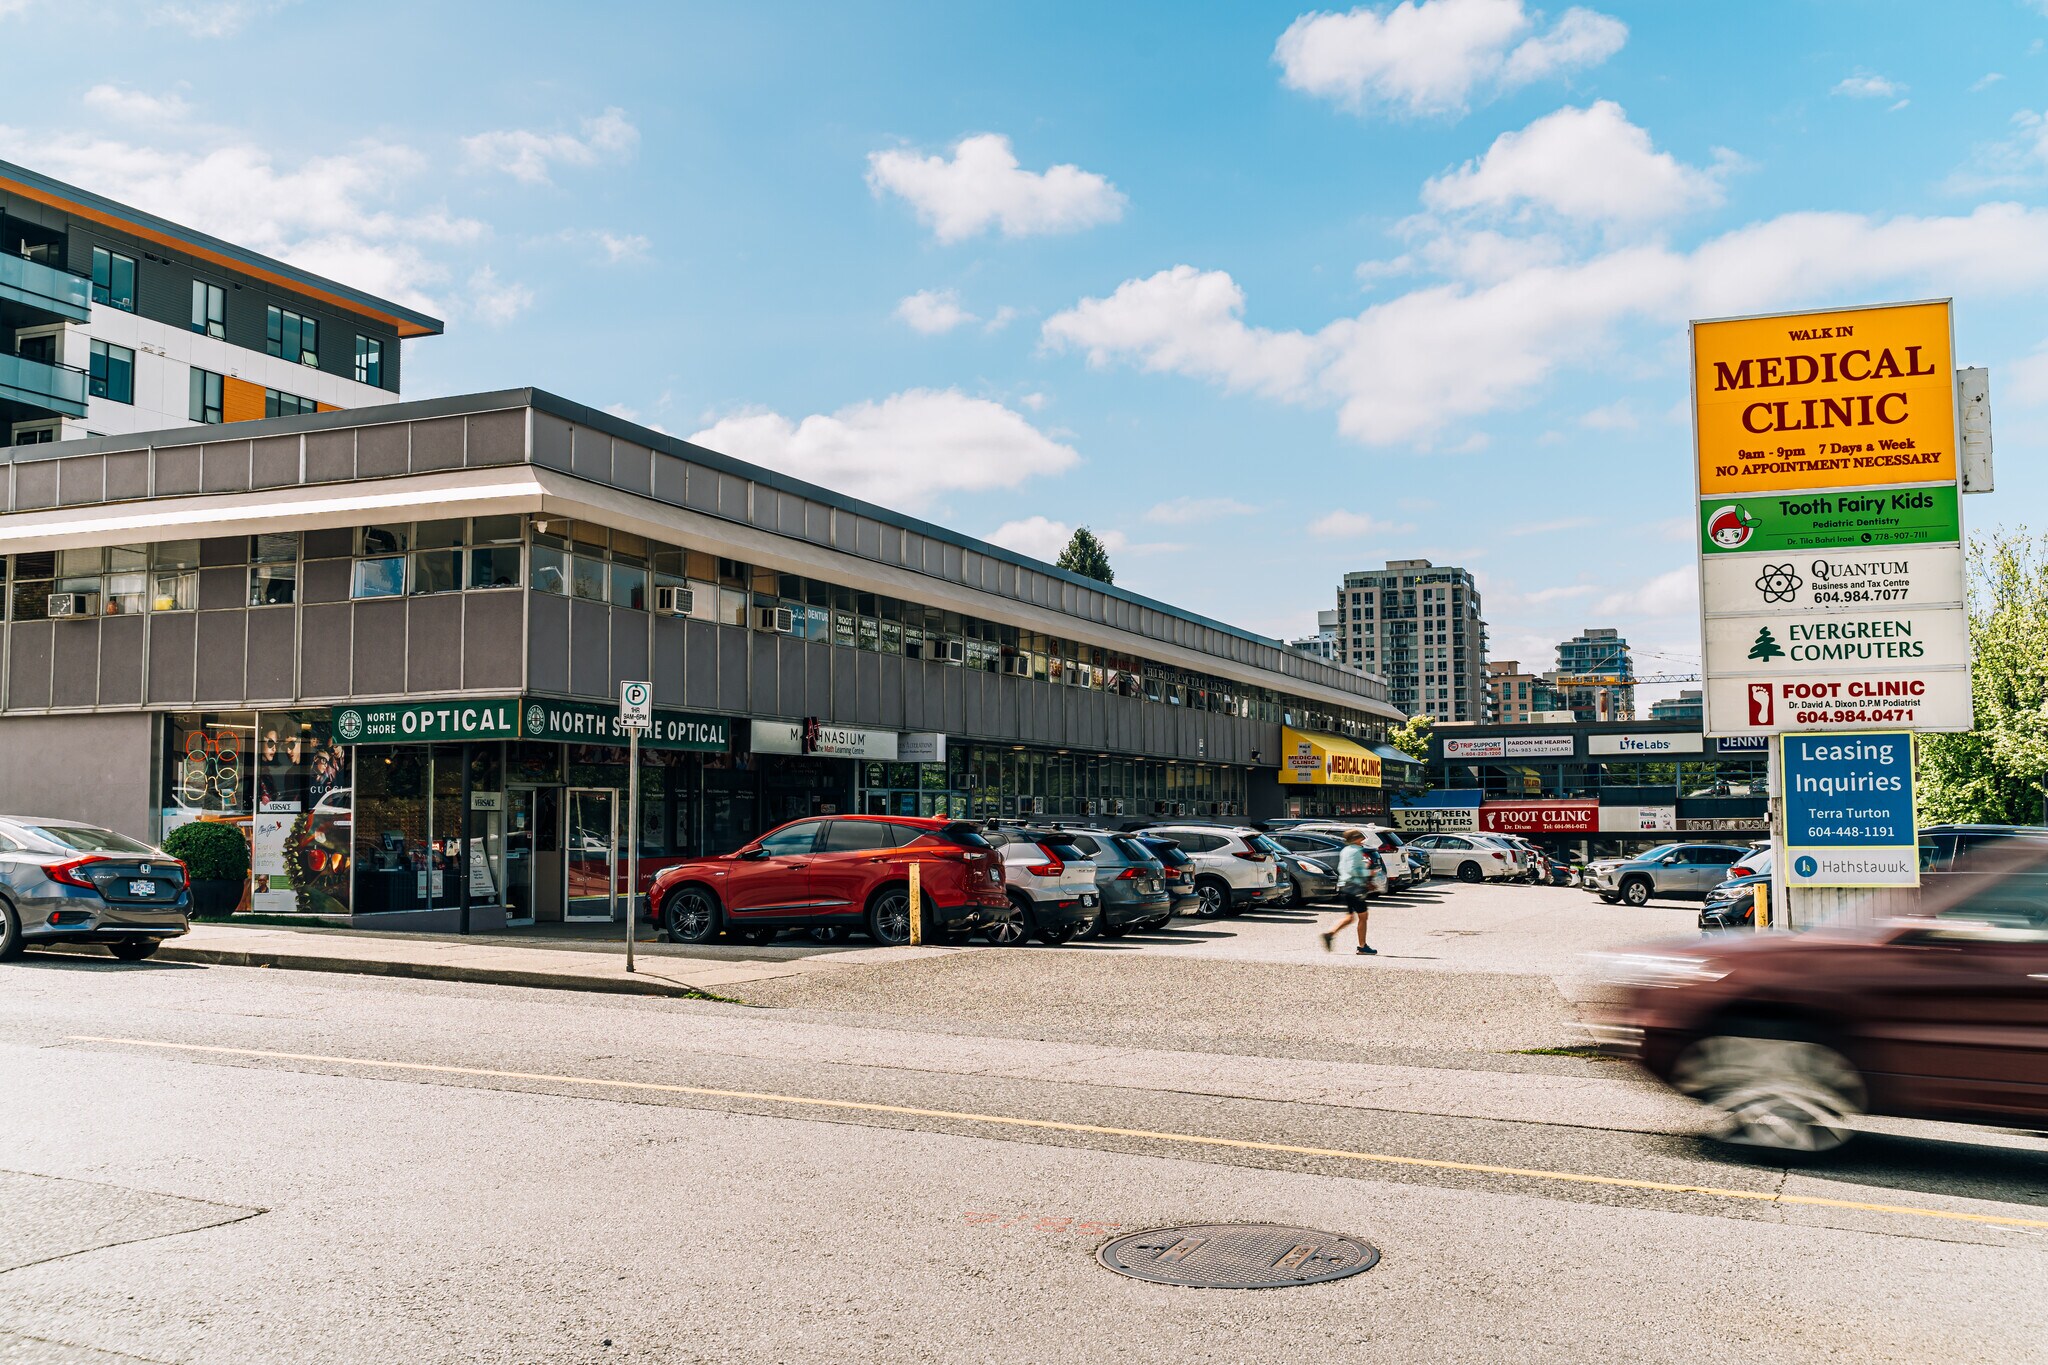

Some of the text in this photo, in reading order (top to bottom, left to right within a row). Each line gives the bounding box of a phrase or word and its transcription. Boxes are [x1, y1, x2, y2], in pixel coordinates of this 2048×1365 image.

[1788, 326, 1854, 341] WALK IN
[1713, 345, 1935, 392] MEDICAL
[1742, 392, 1909, 434] CLINIC
[1738, 449, 1765, 460] 9am
[1777, 447, 1806, 459] 9pm
[1819, 444, 1826, 454] 7
[1830, 443, 1862, 456] Days
[1878, 438, 1915, 450] Week
[1716, 452, 1941, 476] NO APPOINTMENT NECESSARY
[1779, 492, 1934, 516] Tooth Fairy Kids
[1812, 517, 1900, 528] Pediatric Dentistry
[1875, 532, 1928, 541] 778-907-7111
[1812, 560, 1909, 581] QUANTUM
[1812, 581, 1848, 590] Business
[1883, 578, 1910, 588] Centre
[1814, 588, 1909, 604] 604.984.7077
[838, 616, 853, 626] ROOT
[836, 624, 854, 635] CANAL
[860, 628, 878, 638] FILLING
[1789, 620, 1912, 640] EVERGREEN
[1790, 640, 1924, 662] COMPUTERS
[1782, 680, 1925, 698] FOOT CLINIC
[1802, 700, 1823, 708] David
[1834, 700, 1858, 708] Dixon
[1859, 700, 1881, 708] D.P.M
[1882, 698, 1920, 708] Podiatrist
[367, 713, 396, 722] NORTH
[402, 708, 510, 734] OPTICAL
[1796, 710, 1914, 724] 604.984.0471
[367, 724, 396, 734] SHORE
[551, 710, 606, 735] NORTH
[668, 721, 725, 744] OPTICAL
[790, 728, 865, 746] MHNASIUM
[1620, 737, 1668, 750] LifeLabs
[1722, 737, 1766, 747] JENNY
[835, 746, 851, 755] Learning
[1802, 740, 1894, 765] Leasing
[1332, 756, 1360, 775] MEDICAL
[1362, 759, 1381, 776] CLINIC
[310, 786, 344, 794] GUCCI
[1796, 772, 1902, 797] Inquiries
[1500, 810, 1591, 823] FOOT CLINIC
[1808, 808, 1890, 818] Terra Turton
[1808, 826, 1894, 837] 604-448-1191
[1822, 860, 1908, 872] Hathstauwk
